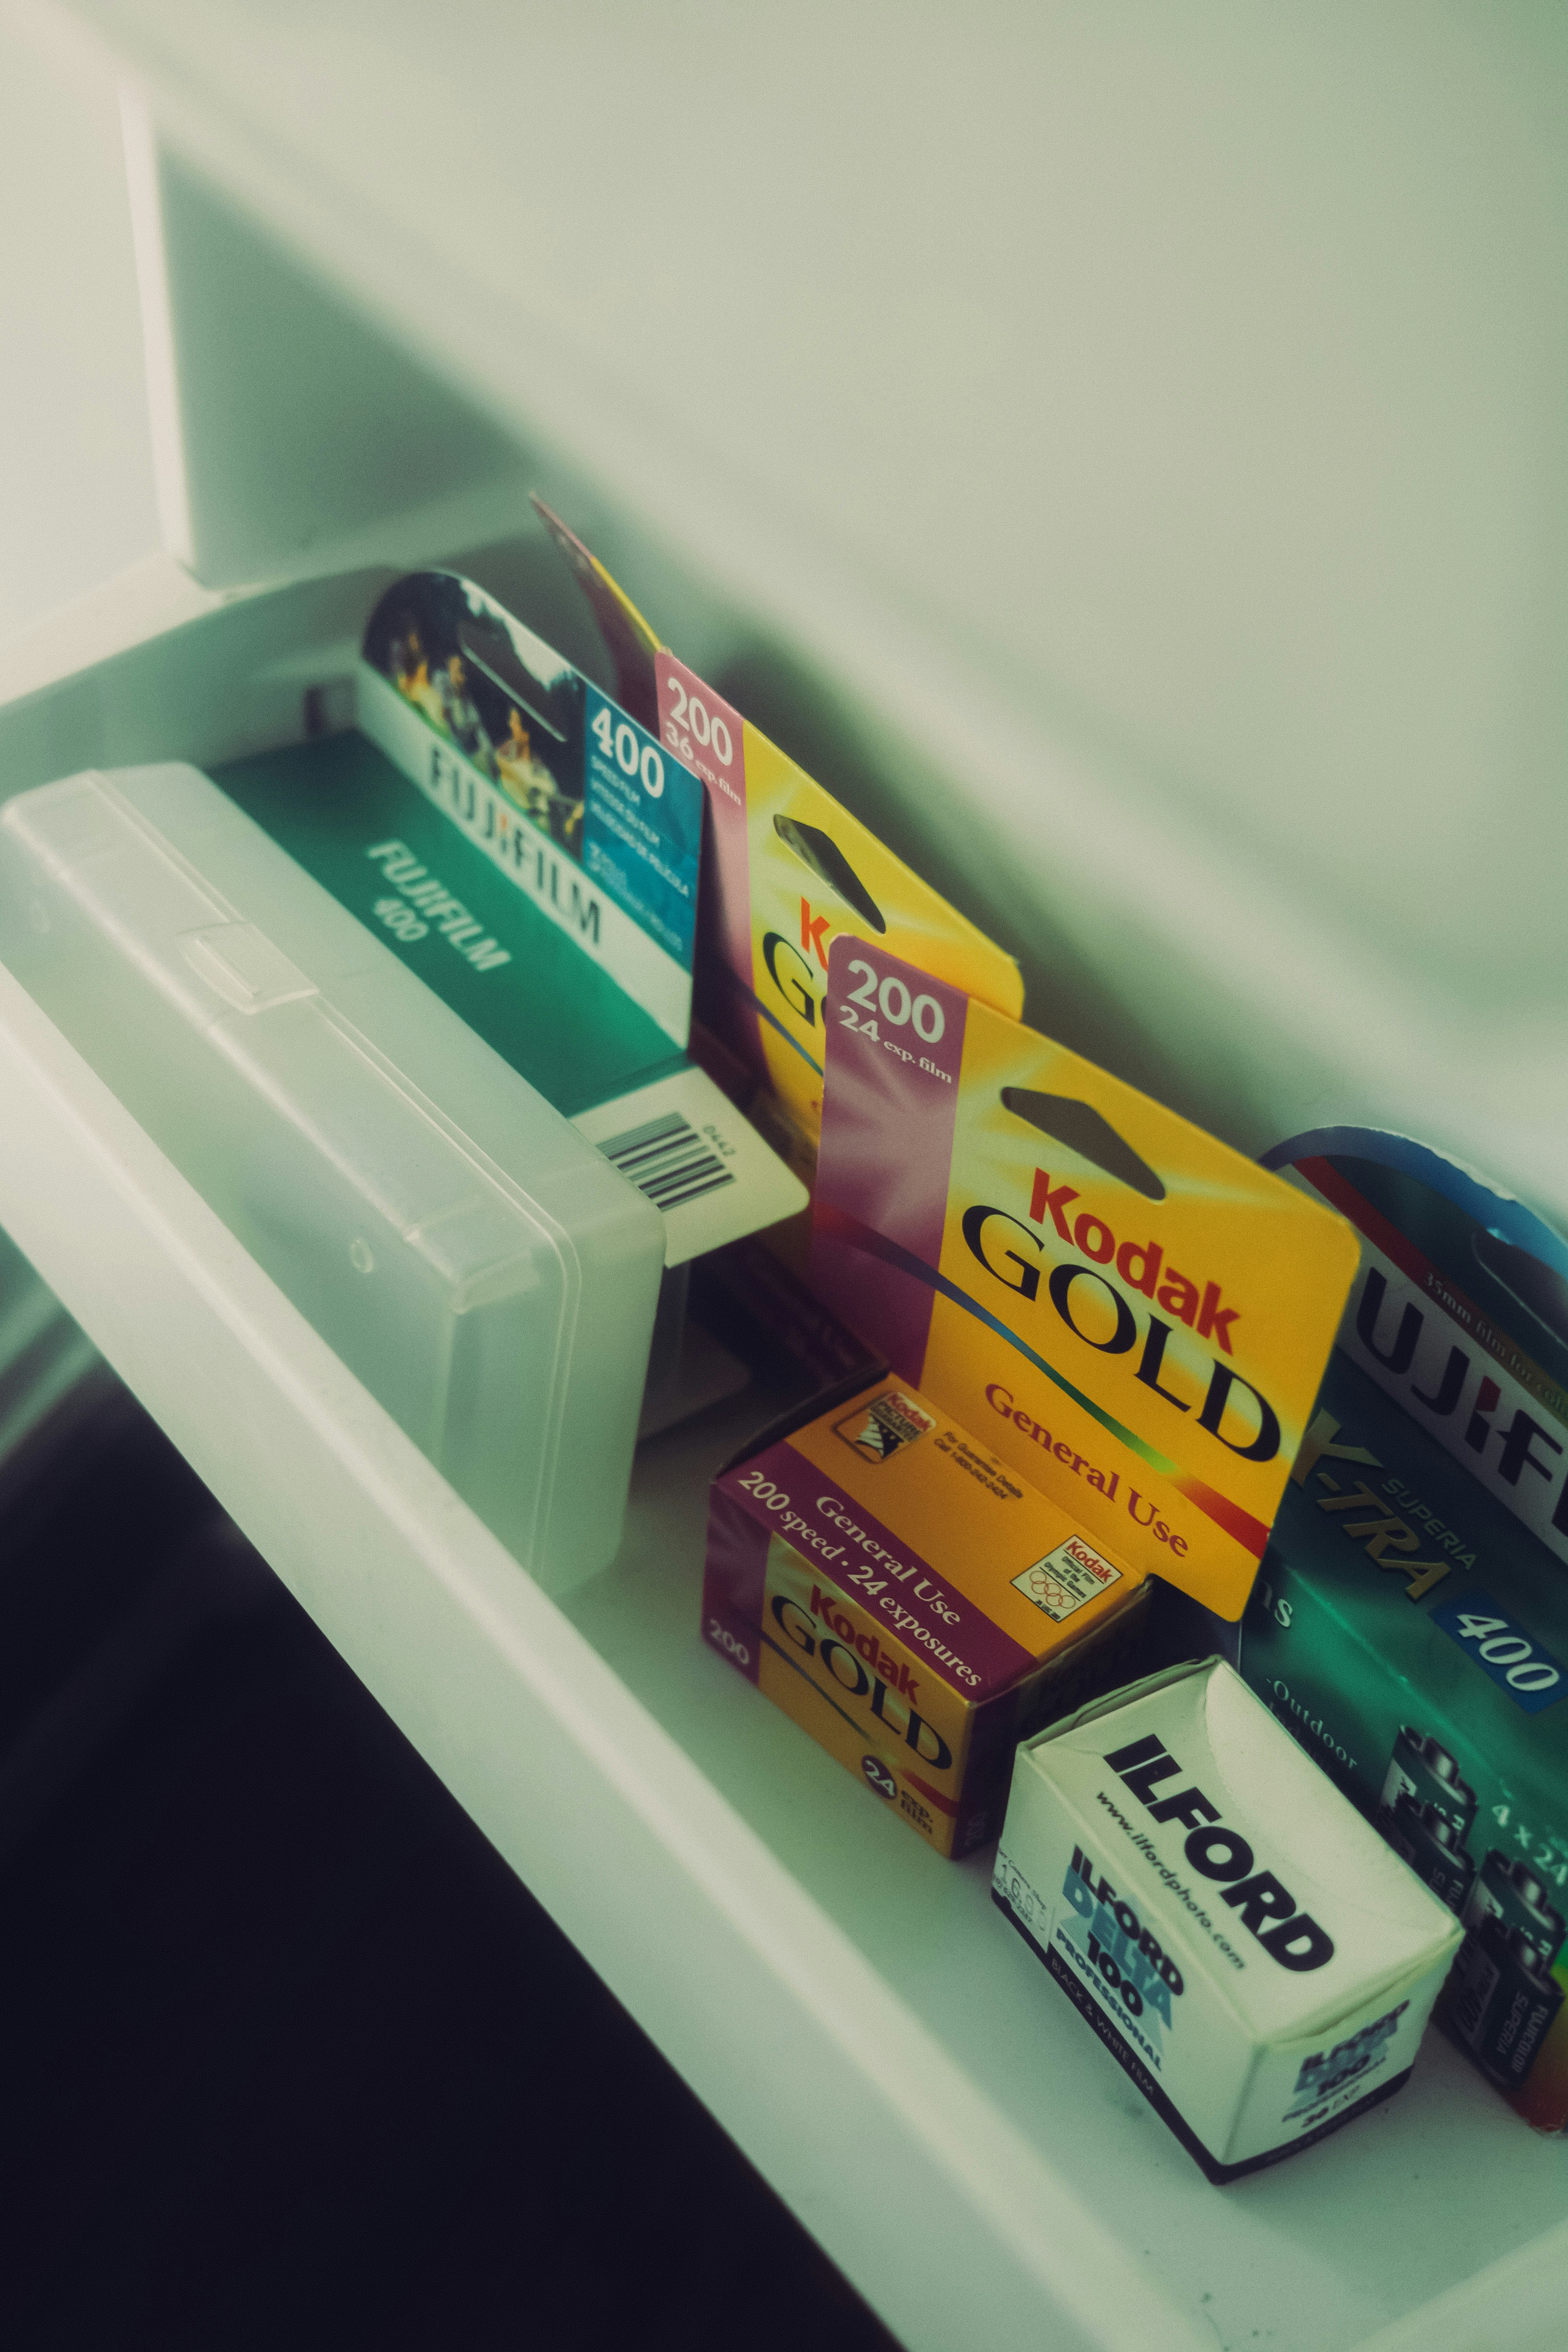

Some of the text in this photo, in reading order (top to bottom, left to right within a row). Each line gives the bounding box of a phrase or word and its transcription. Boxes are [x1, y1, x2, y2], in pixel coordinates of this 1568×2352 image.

[592, 708, 665, 797] 400
[666, 722, 693, 760] 36
[719, 778, 741, 806] film
[667, 677, 733, 766] 200
[433, 747, 601, 945] FUJIFILM
[366, 839, 511, 971] FUJIFILM
[374, 898, 428, 941] 400
[839, 1005, 952, 1084] 24 exp. film
[847, 960, 945, 1043] 200
[1029, 1166, 1241, 1357] Kodak
[962, 1205, 1281, 1462] GOLD
[1428, 1273, 1470, 1323] 35mm
[1476, 1321, 1506, 1357] film
[1356, 1267, 1568, 1537] UJIF
[985, 1384, 1188, 1558] General Use
[816, 1496, 960, 1625] General Use
[1066, 1541, 1113, 1583] Kodak
[1382, 1479, 1478, 1571] SUPERIA
[738, 1472, 982, 1686] 200 speed 24 exposures
[709, 1619, 750, 1665] 200
[771, 1595, 952, 1770] GOLD
[811, 1584, 920, 1706] Kodak
[1457, 1614, 1559, 1691] 400
[865, 1760, 896, 1797] 24
[901, 1790, 934, 1823] exp.
[1097, 1791, 1246, 1969] www.ilfordphoto.com
[1103, 1733, 1335, 1972] ILFORD
[1070, 1844, 1185, 1996] ILFORD
[1051, 1958, 1083, 2004] BLACK
[1097, 2018, 1130, 2062] WHITE
[1056, 1927, 1162, 2072] PROFESSIONAL
[1087, 1930, 1143, 2017] 100
